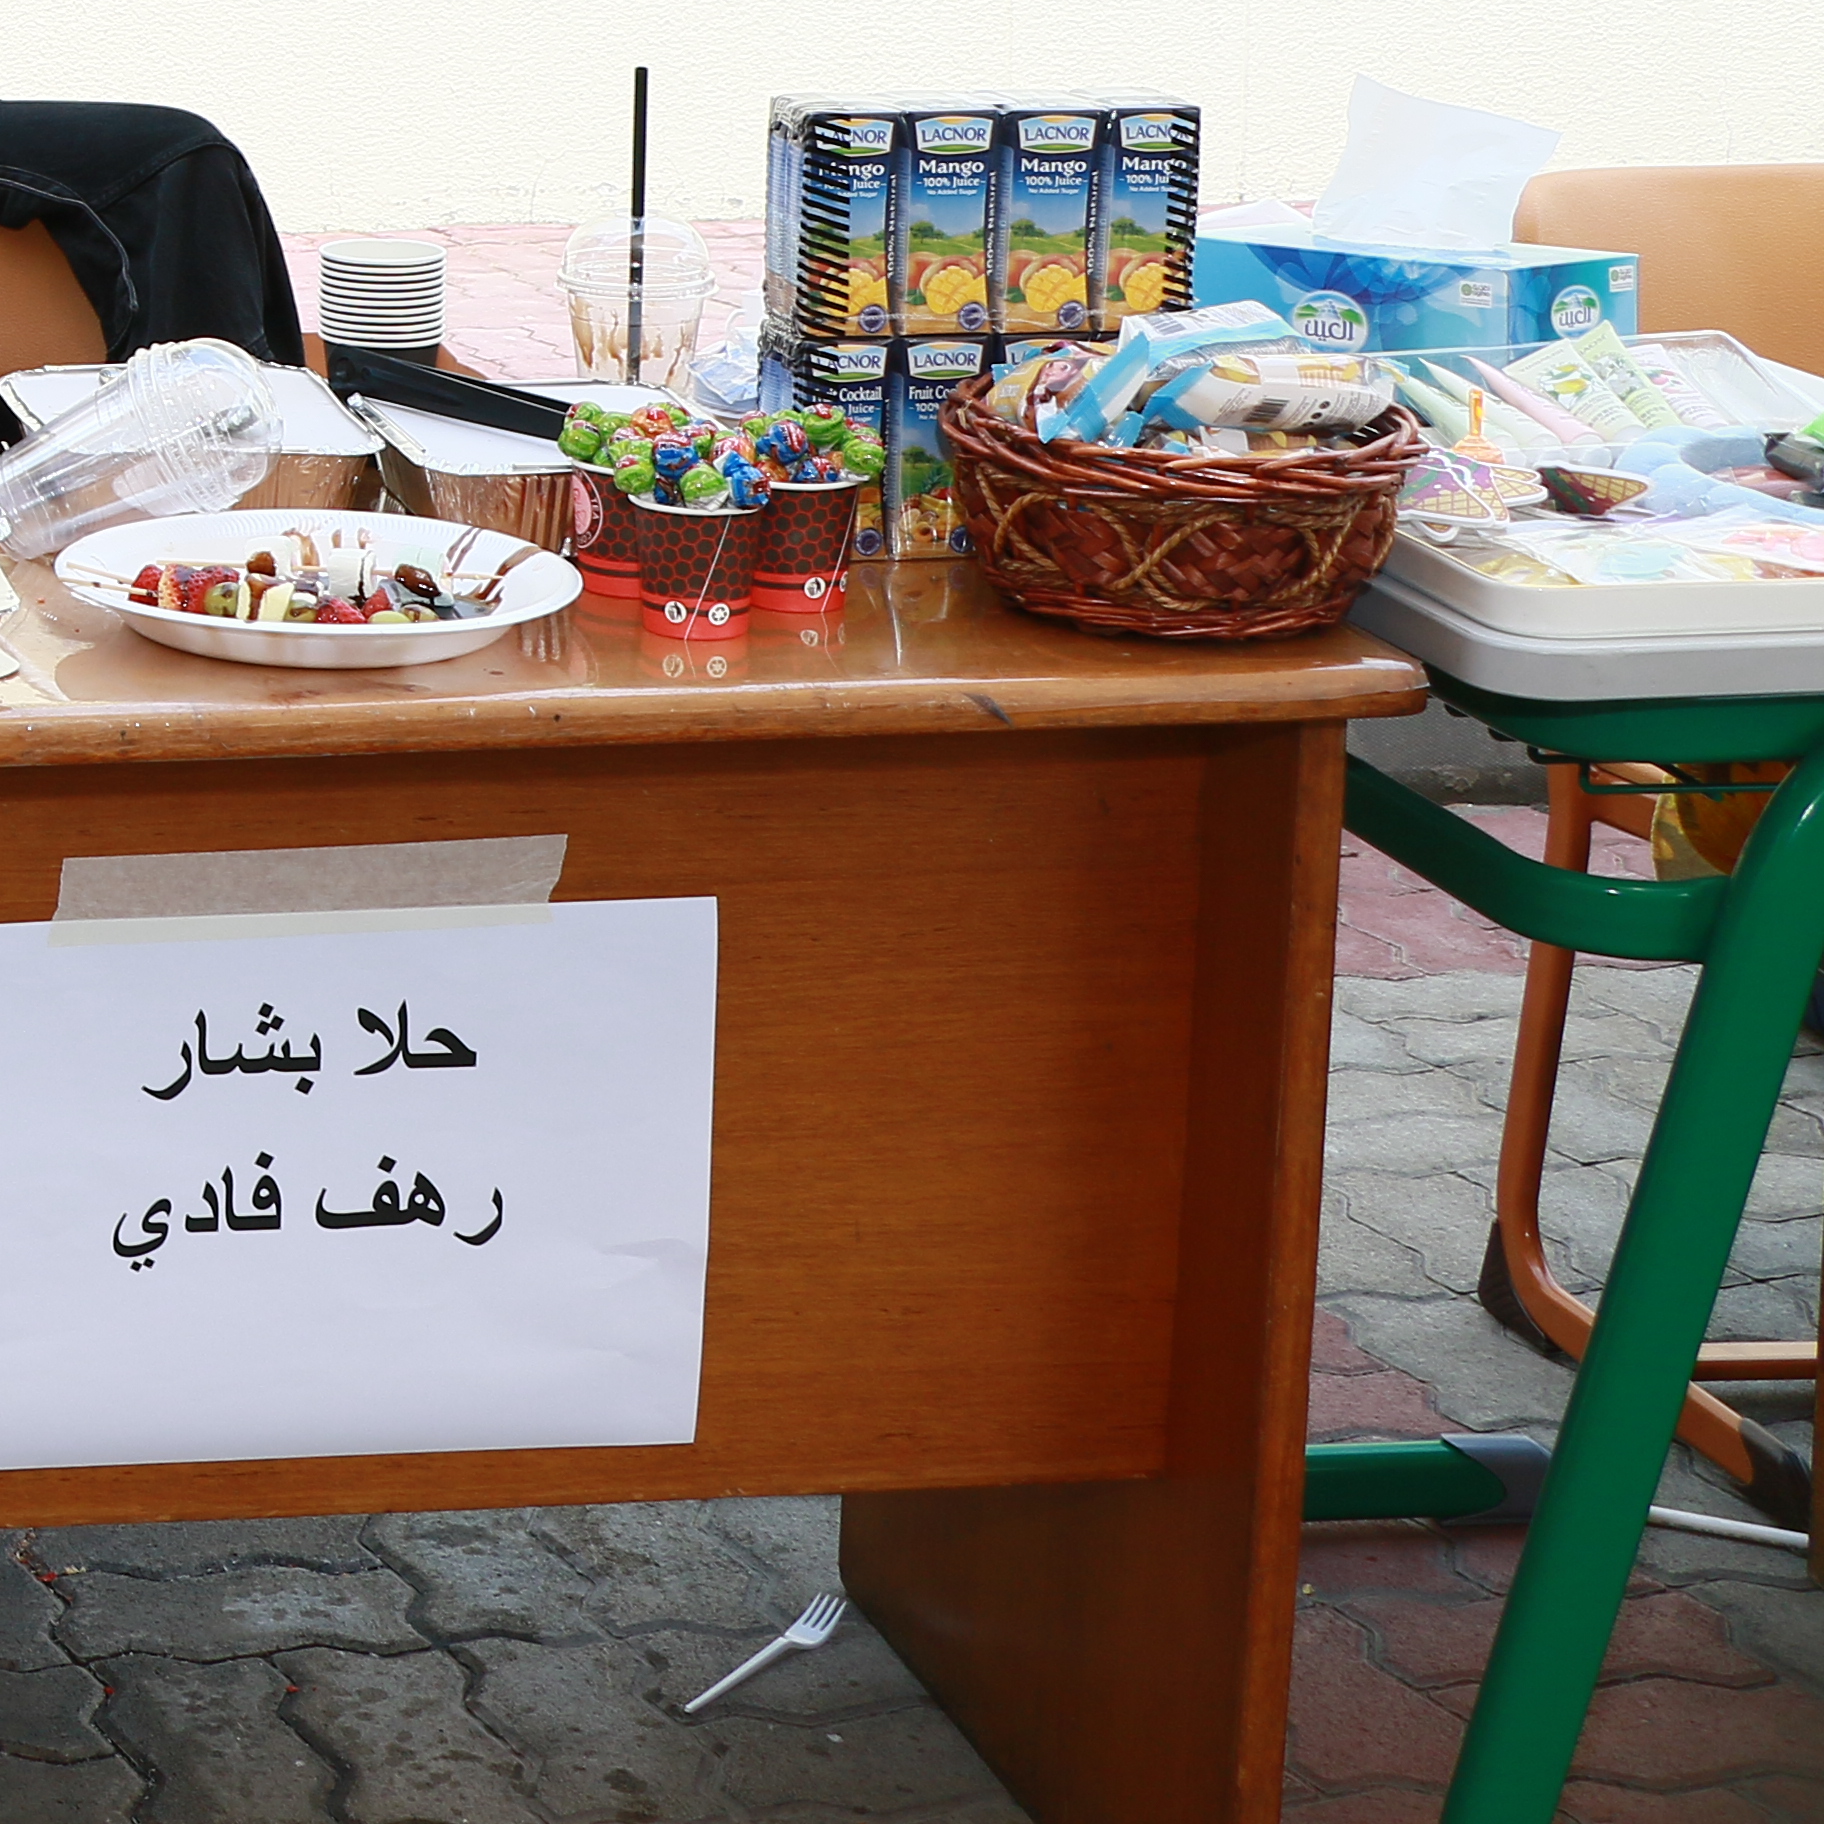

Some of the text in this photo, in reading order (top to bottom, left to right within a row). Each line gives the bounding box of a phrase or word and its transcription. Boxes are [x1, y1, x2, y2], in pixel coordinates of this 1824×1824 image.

[922, 127, 987, 143] LACNOR
[1024, 126, 1091, 142] LACNOR
[919, 159, 984, 179] Mango
[1021, 158, 1087, 177] Mango
[1304, 319, 1354, 342] العين
[914, 353, 977, 368] LACNOR
[839, 386, 883, 401] Cocktail
[908, 385, 934, 399] Fruit
[141, 998, 477, 1101] حلا بشار
[112, 1150, 503, 1272] رهف فادي
